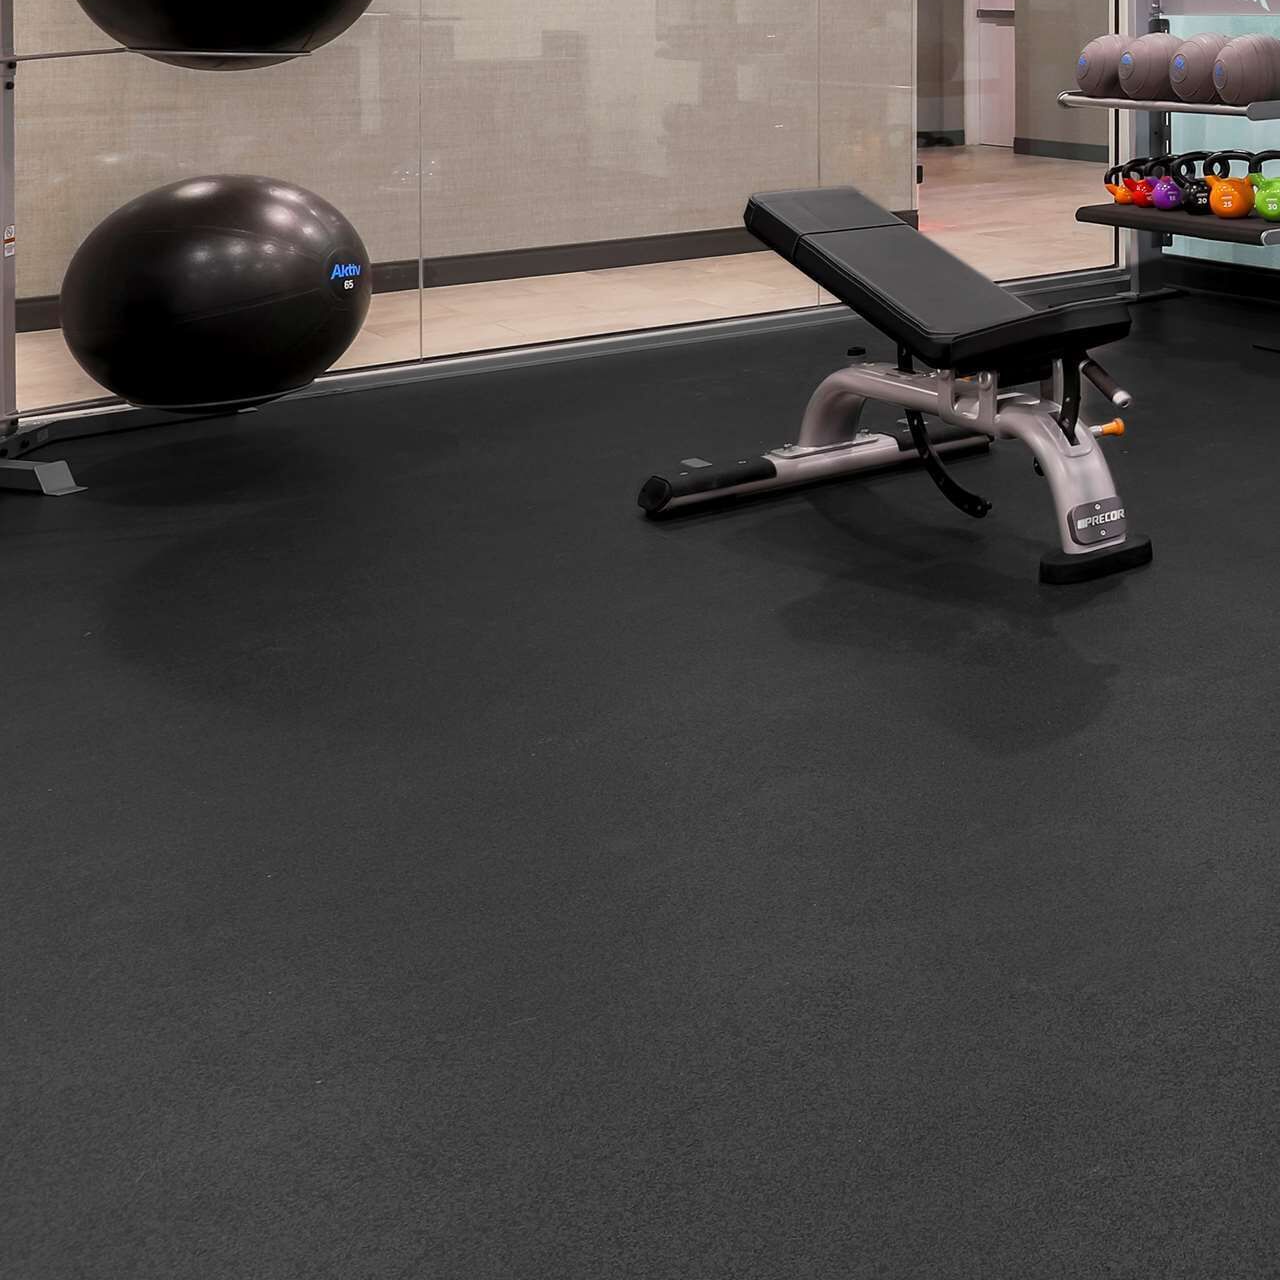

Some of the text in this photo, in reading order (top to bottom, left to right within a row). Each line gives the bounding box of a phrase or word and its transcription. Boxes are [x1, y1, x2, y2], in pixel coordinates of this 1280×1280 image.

[330, 263, 361, 280] Aktiv
[343, 279, 354, 290] 65
[1085, 509, 1125, 528] PRECOR
